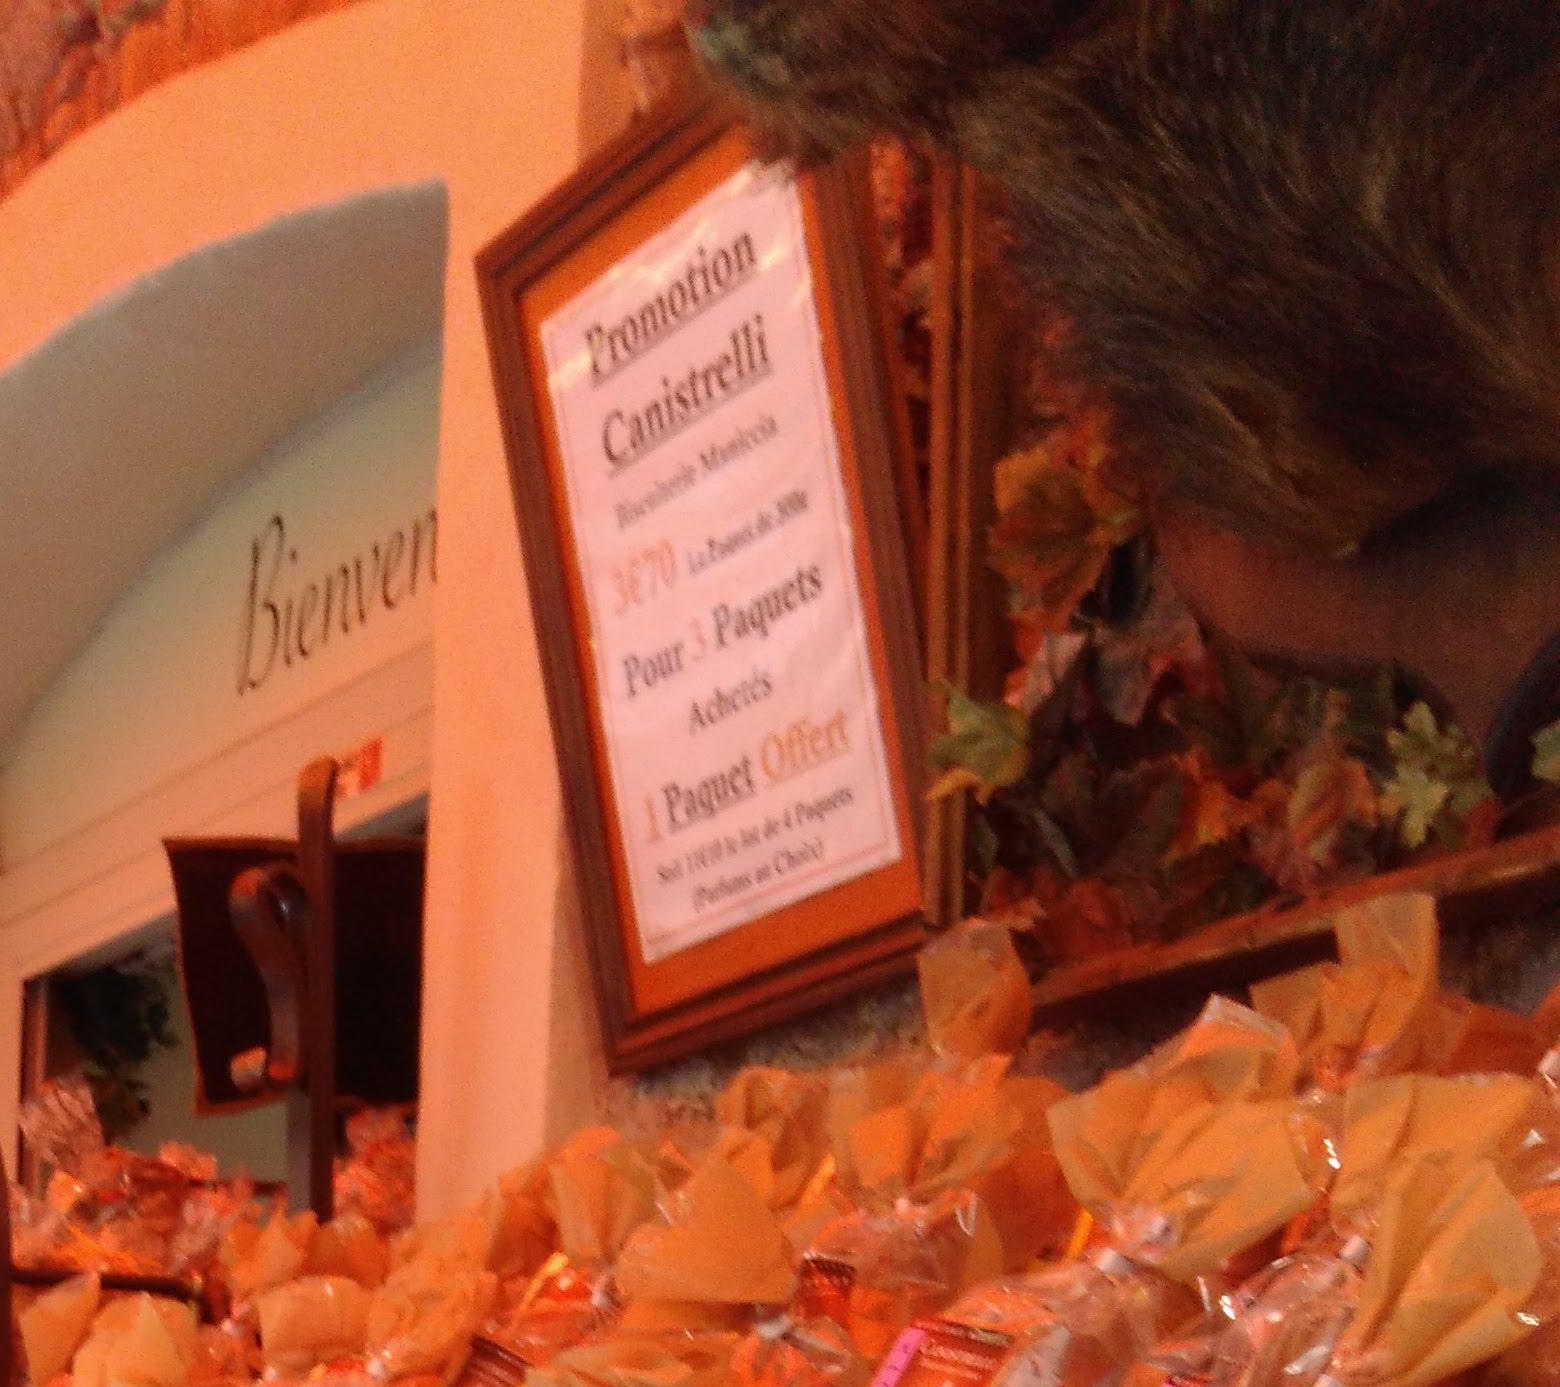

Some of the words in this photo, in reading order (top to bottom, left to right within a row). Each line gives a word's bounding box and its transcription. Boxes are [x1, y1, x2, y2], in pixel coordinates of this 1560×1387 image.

[586, 229, 758, 378] Promotion
[602, 313, 771, 468] Canistrelli
[623, 640, 685, 699] Pour
[691, 616, 708, 662] 3
[712, 562, 823, 649] Paquets
[690, 666, 774, 736] Achetés
[645, 792, 661, 845] 1
[663, 755, 756, 835] Paquet
[759, 708, 852, 787] Offert
